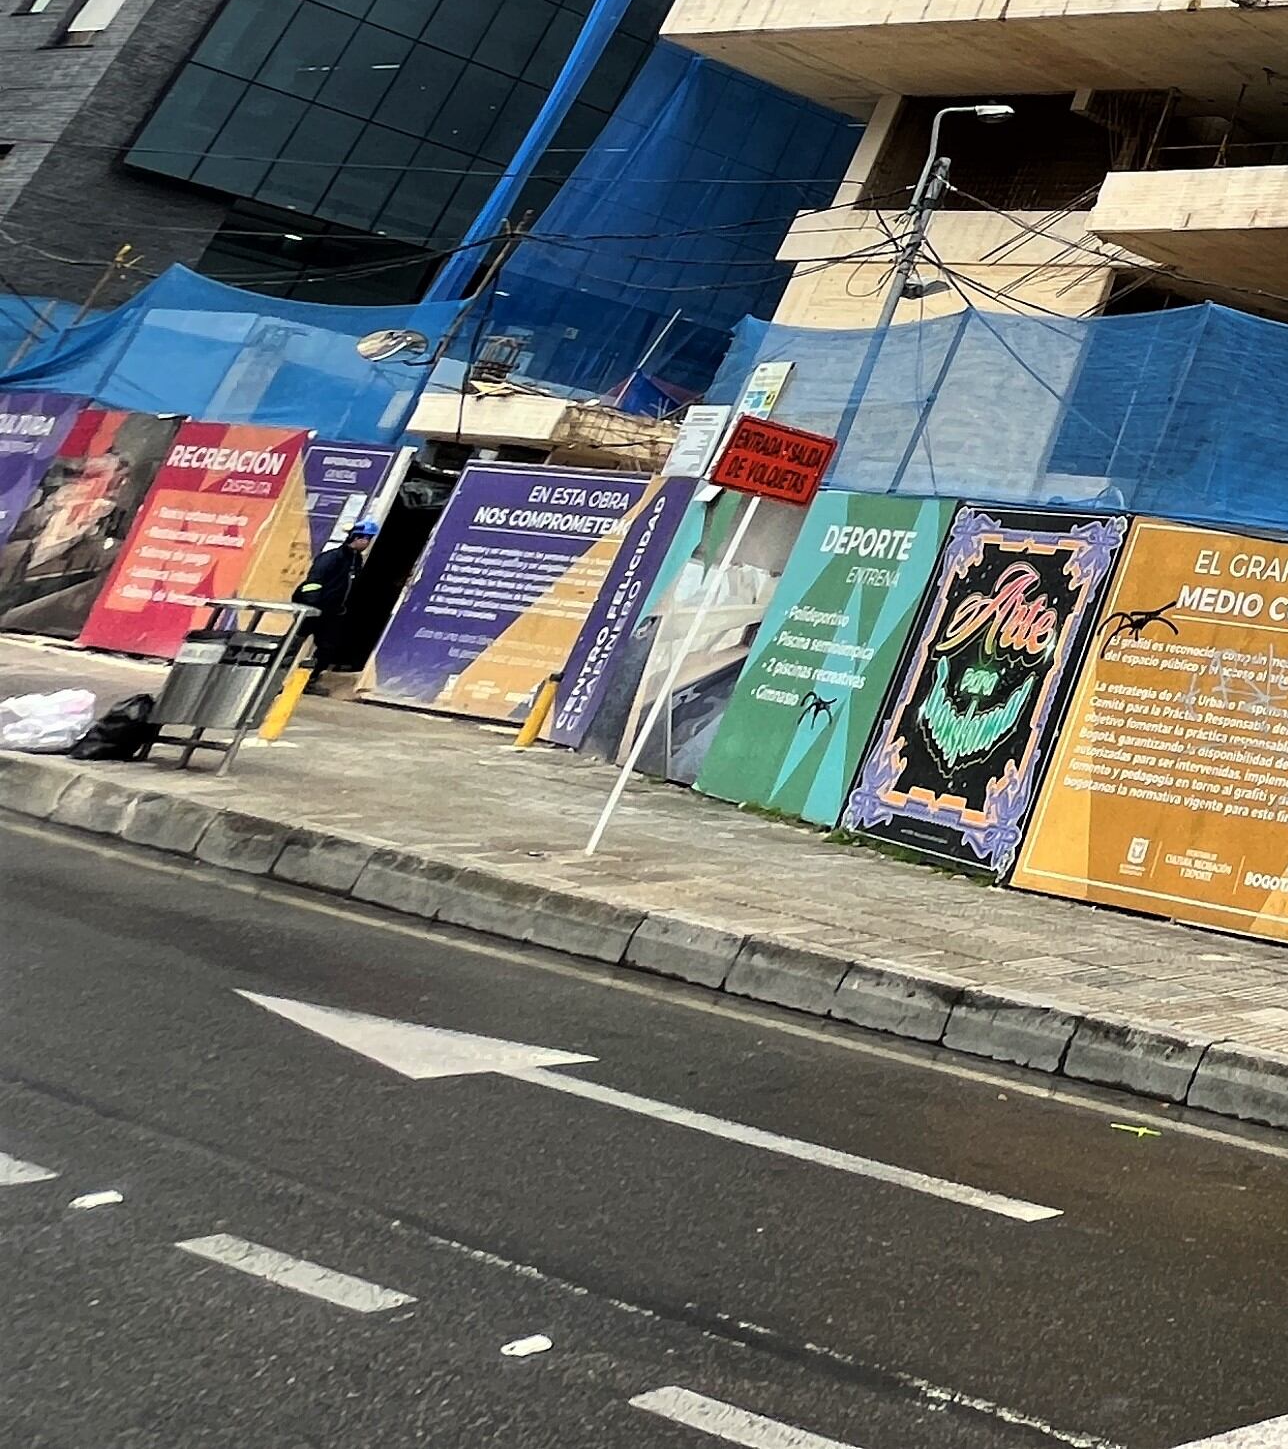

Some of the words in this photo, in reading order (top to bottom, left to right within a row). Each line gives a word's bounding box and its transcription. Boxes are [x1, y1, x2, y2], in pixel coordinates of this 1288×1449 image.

[167, 444, 286, 475] RECREACIÓN
[528, 486, 549, 503] EN
[551, 488, 586, 508] ESTA
[589, 490, 630, 510] OBRA
[474, 507, 507, 526] NOS
[820, 525, 918, 561] DEPORTE
[1194, 550, 1222, 575] EL
[846, 566, 901, 587] ENTRENA
[556, 626, 609, 730] CENTRO
[606, 496, 666, 620] FELICIDAD
[1176, 585, 1263, 618] MEDIO
[777, 630, 810, 651] Piscina
[765, 657, 777, 673] 2
[772, 659, 812, 680] piscinas
[812, 670, 866, 689] recreativas
[1122, 652, 1159, 667] espacio
[1160, 656, 1198, 672] público
[755, 684, 800, 706] Gimnasio
[1090, 696, 1125, 710] Comité
[1108, 684, 1158, 700] estrategia
[1085, 713, 1125, 728] objetivo
[1126, 717, 1173, 734] fomentar
[1185, 726, 1228, 742] práctica
[1118, 735, 1184, 753] garantizando
[1198, 746, 1273, 767] disponibilidad
[1069, 758, 1111, 776] fomento
[1119, 769, 1174, 787] pedagogía
[1191, 780, 1221, 793] torno
[1063, 775, 1116, 794] bogotanos
[1128, 787, 1181, 805] normativa
[1183, 796, 1223, 811] vigente
